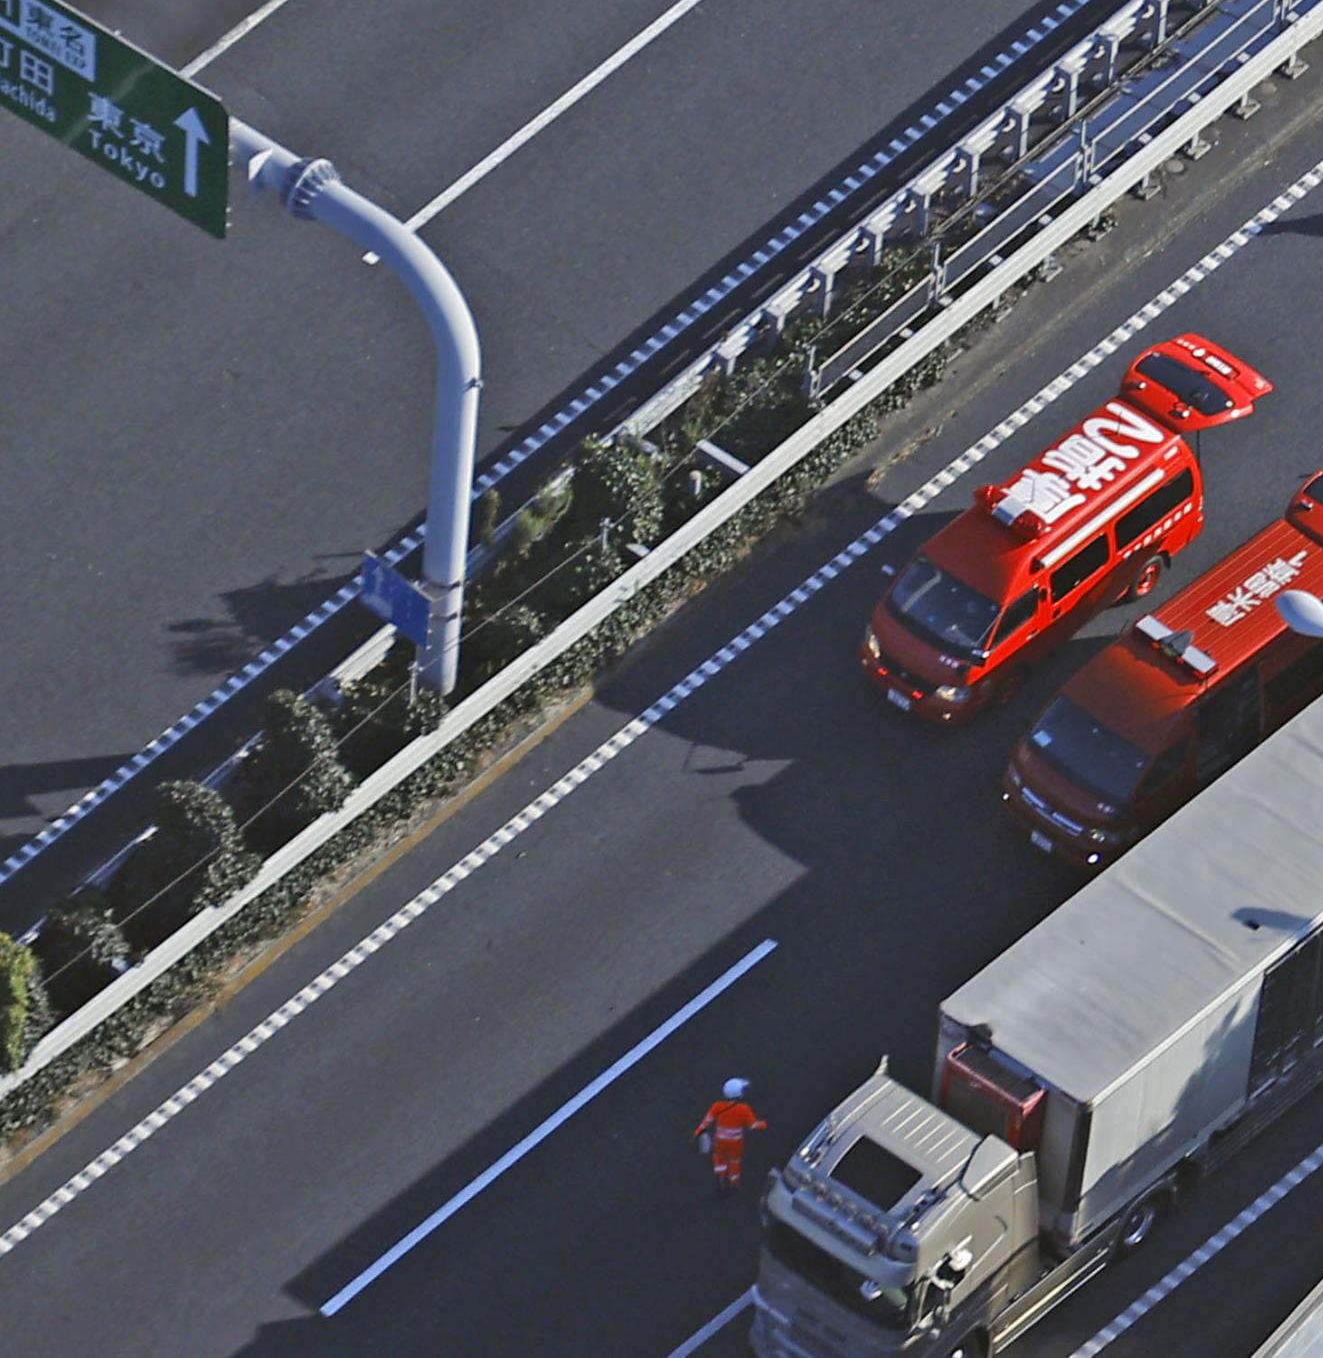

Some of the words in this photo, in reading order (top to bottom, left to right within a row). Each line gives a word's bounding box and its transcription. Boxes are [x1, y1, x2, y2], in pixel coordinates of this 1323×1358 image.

[26, 2, 86, 58] 東名
[0, 78, 56, 123] achida
[86, 91, 166, 164] 東京
[88, 128, 166, 189] Tokyo
